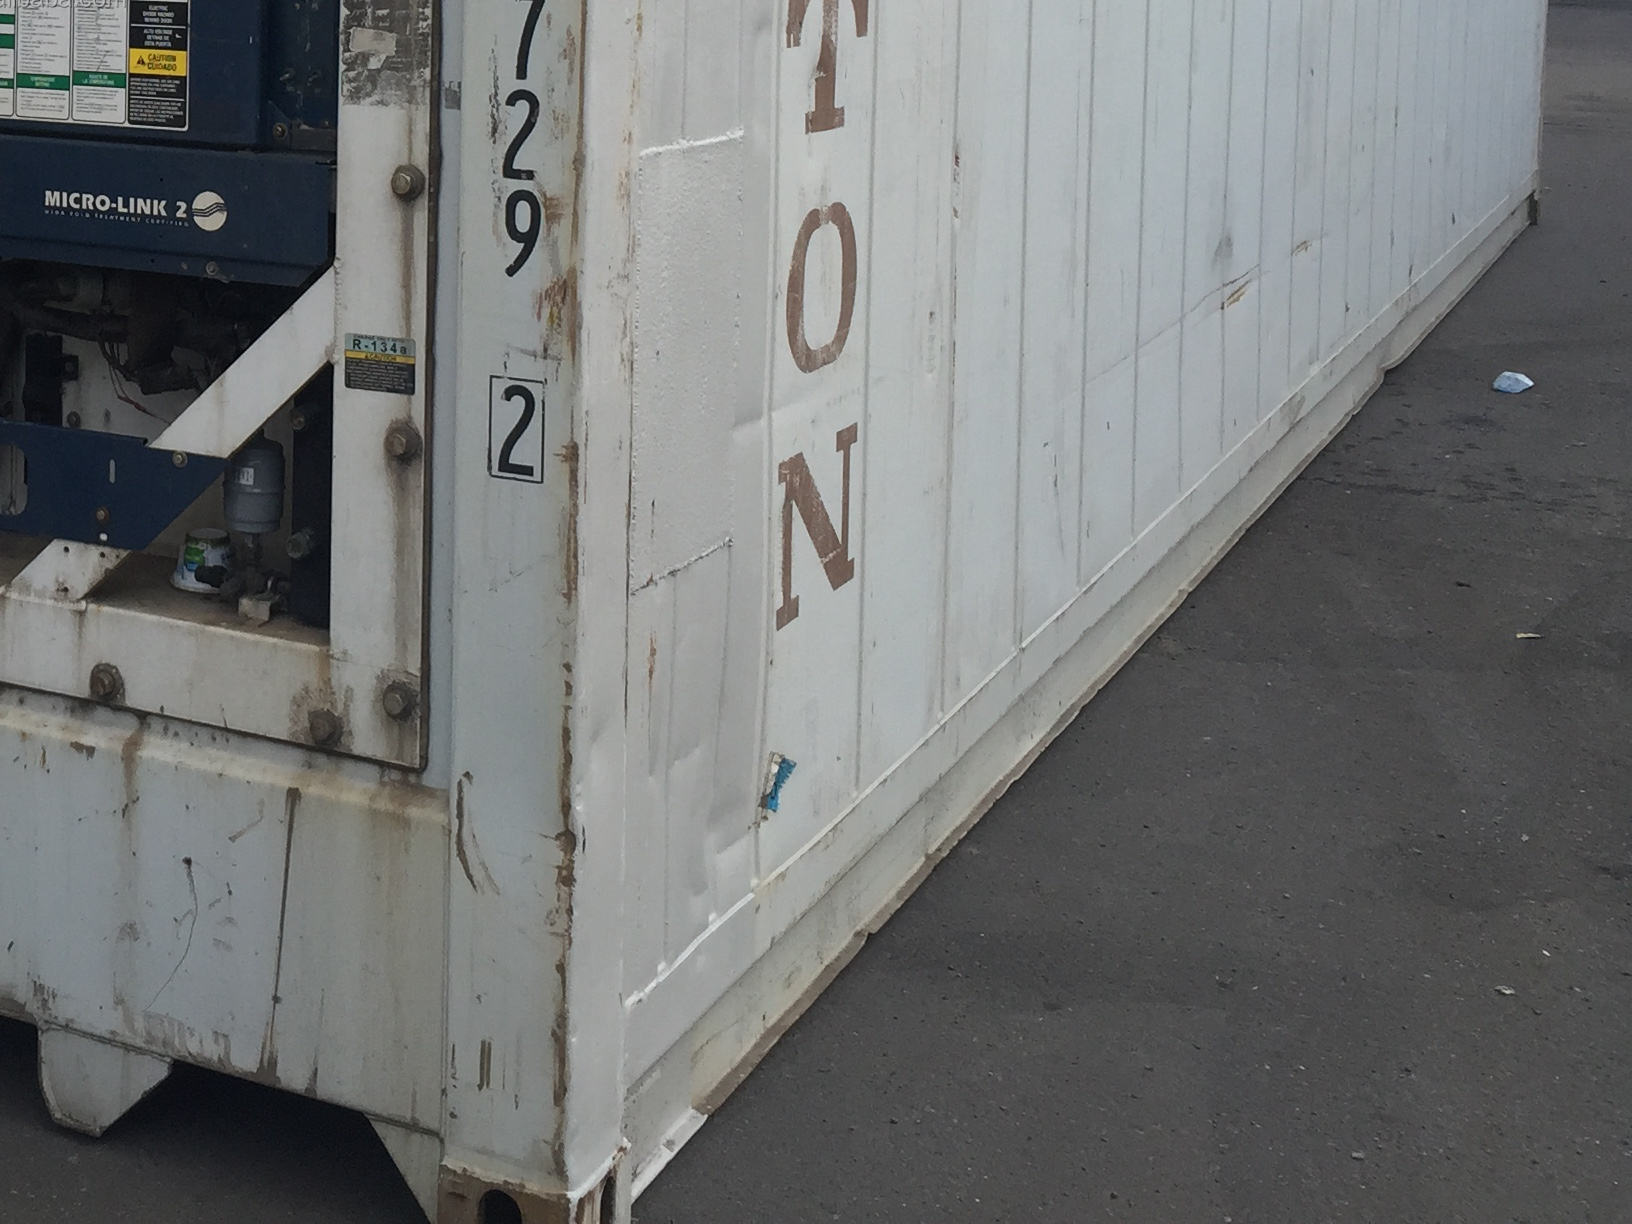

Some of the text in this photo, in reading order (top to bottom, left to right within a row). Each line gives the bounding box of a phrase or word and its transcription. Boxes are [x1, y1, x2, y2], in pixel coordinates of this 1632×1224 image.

[147, 53, 177, 63] CAUTION
[147, 62, 178, 72] CUIDADO
[44, 189, 188, 219] MICRO-LINK 2
[352, 338, 407, 355] R-134a
[497, 384, 536, 476] 2
